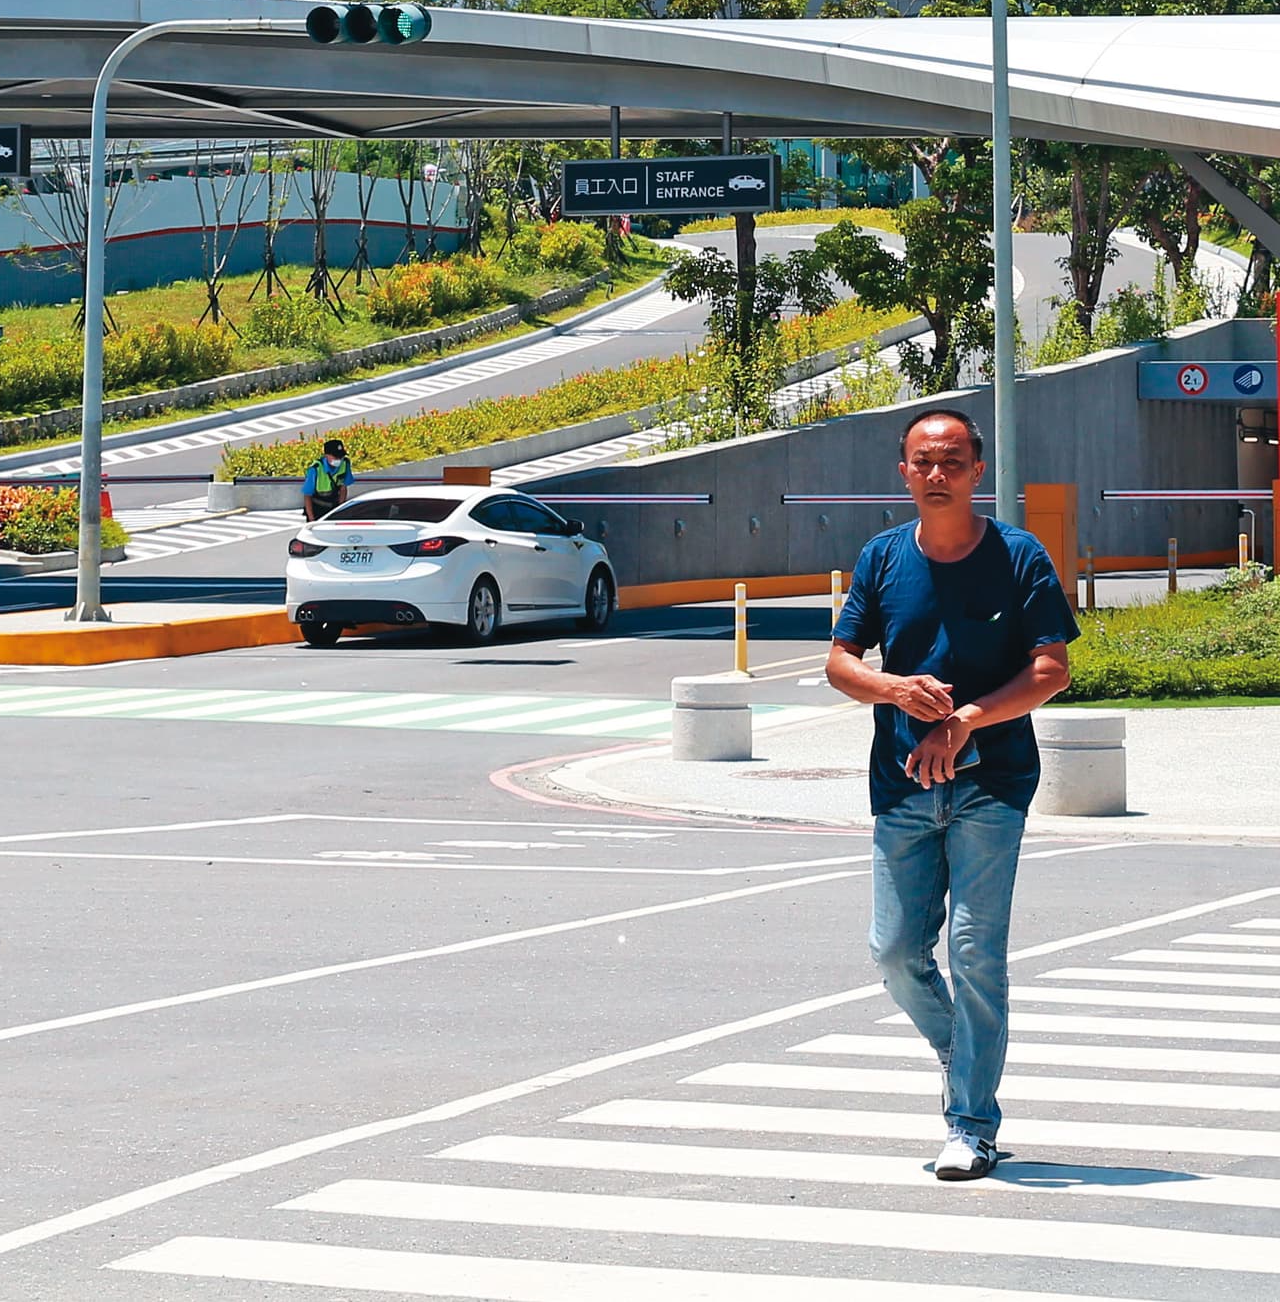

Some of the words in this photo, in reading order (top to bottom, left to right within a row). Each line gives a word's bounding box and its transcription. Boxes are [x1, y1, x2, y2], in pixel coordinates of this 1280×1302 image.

[656, 171, 695, 183] STAFF
[574, 178, 638, 196] 員工入口
[656, 186, 725, 199] ENTRANCE
